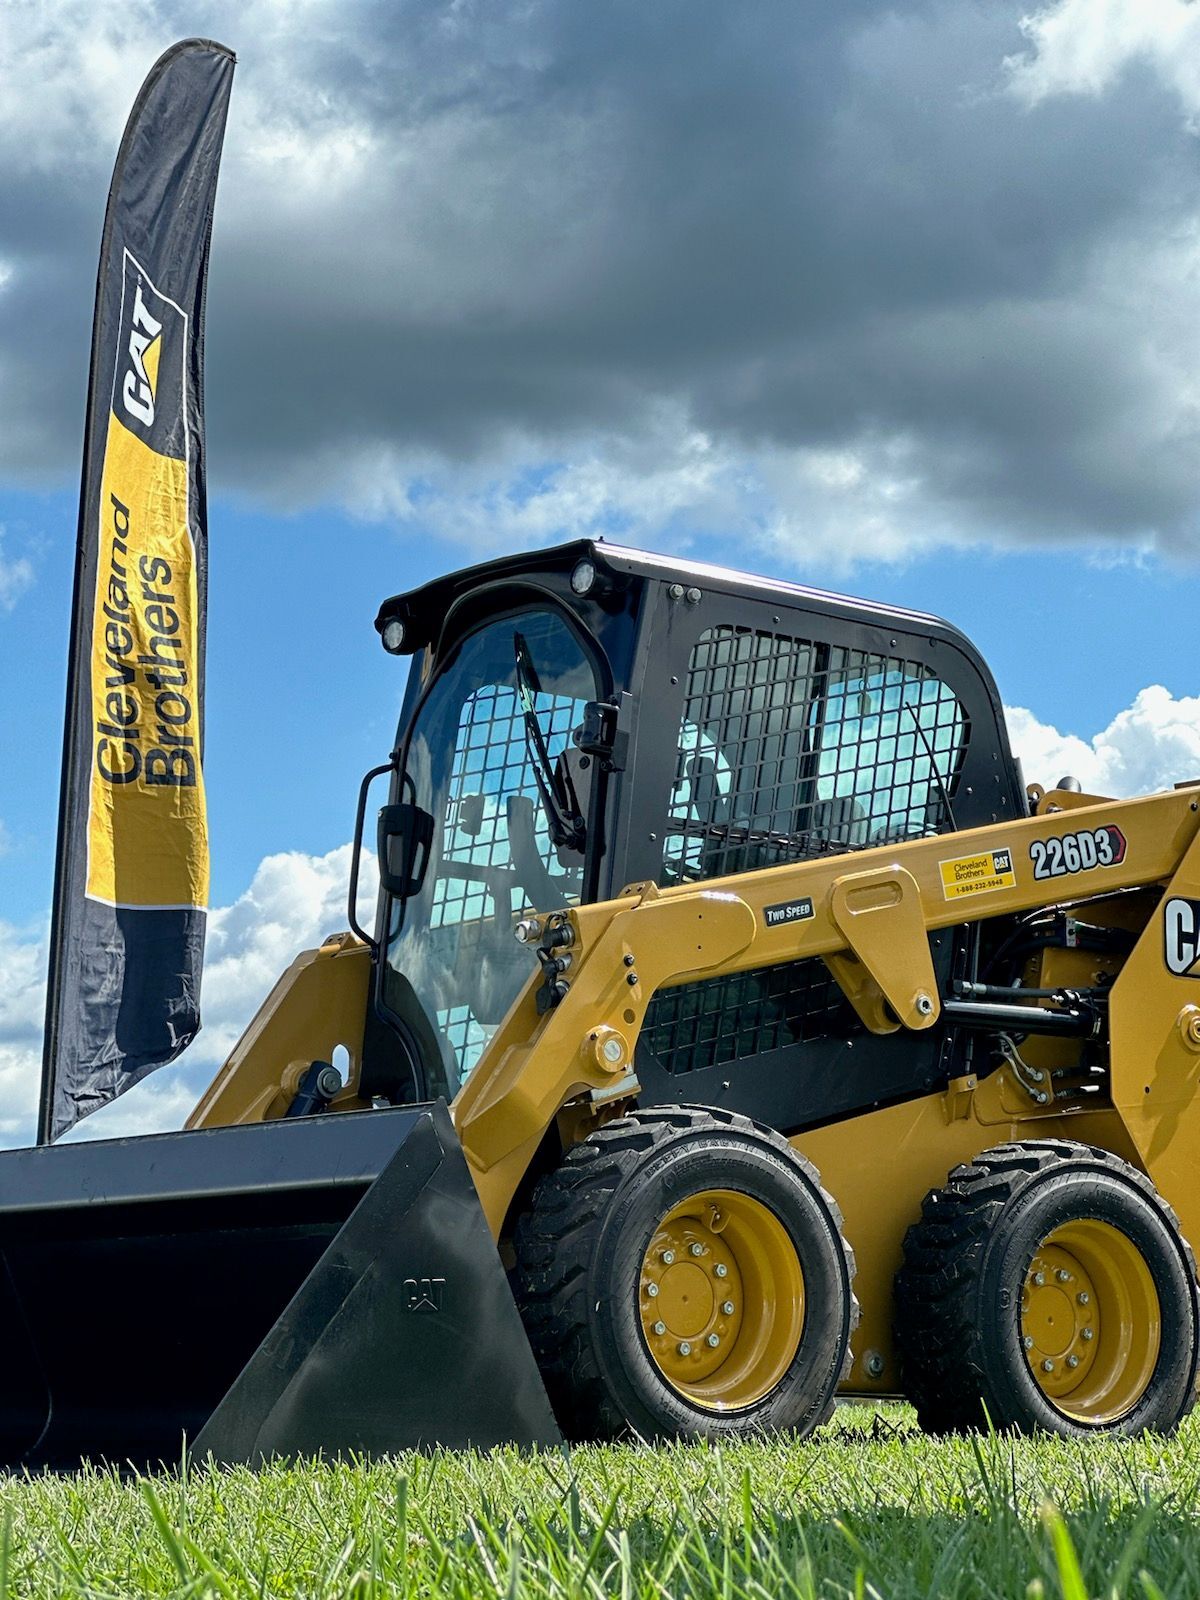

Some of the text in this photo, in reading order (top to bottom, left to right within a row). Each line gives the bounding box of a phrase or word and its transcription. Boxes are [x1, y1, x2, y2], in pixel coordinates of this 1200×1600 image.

[123, 285, 162, 427] CAT
[96, 492, 143, 785] Cleveland
[137, 554, 198, 787] Brothers
[954, 859, 988, 872] Cleveland
[955, 869, 985, 880] Brothers
[994, 856, 1009, 870] CAT
[1030, 828, 1114, 879] 226D3
[1165, 898, 1200, 974] C
